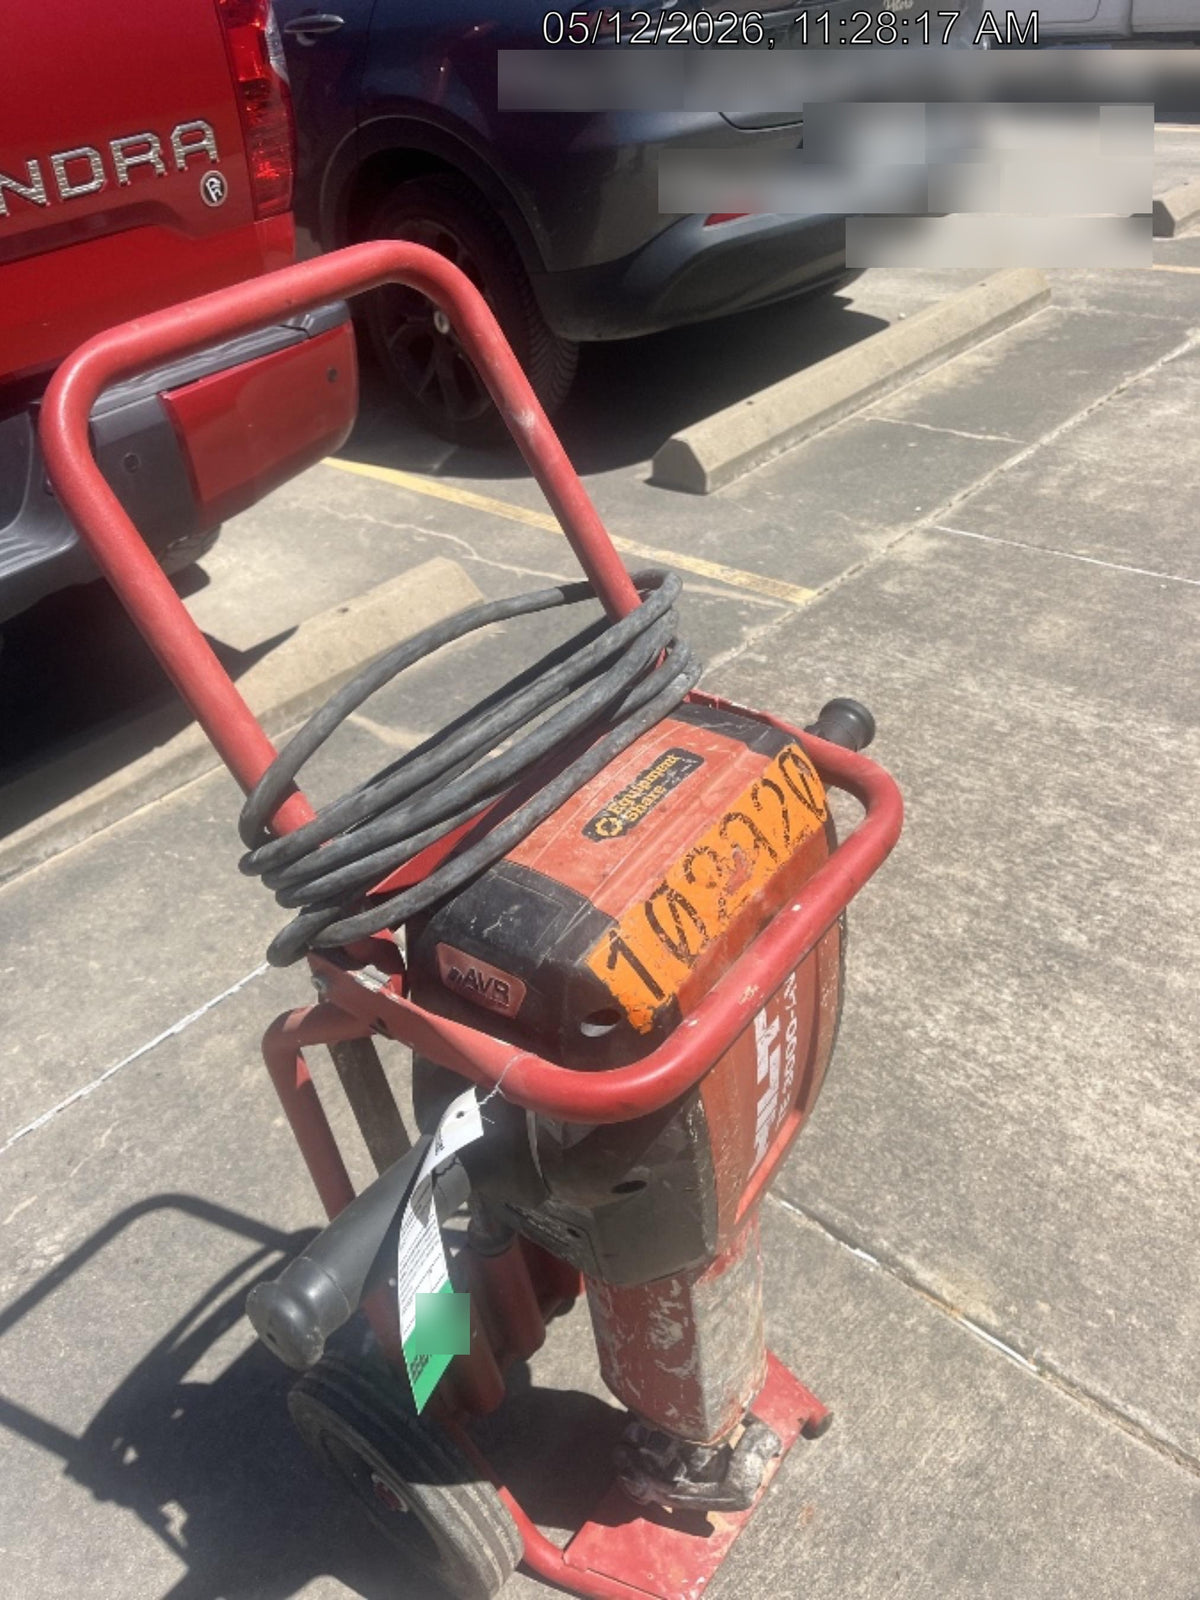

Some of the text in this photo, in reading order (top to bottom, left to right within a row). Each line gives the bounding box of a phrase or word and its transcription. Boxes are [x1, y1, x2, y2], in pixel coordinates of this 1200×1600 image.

[607, 753, 682, 815] Equipment
[625, 784, 668, 823] Share
[747, 1007, 781, 1179] HILT
